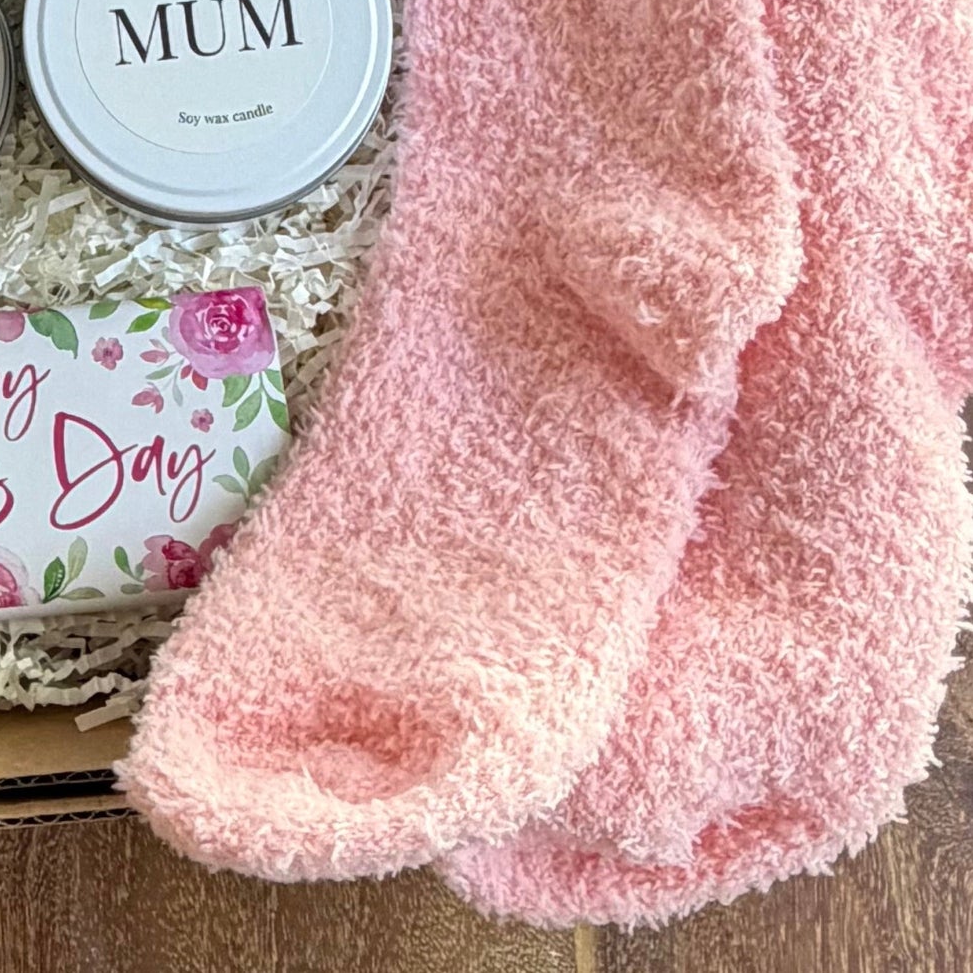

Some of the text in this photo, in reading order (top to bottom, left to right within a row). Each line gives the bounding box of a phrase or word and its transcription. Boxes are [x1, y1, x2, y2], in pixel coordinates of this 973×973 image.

[178, 103, 274, 126] Soy wax candle
[49, 411, 217, 531] Day
